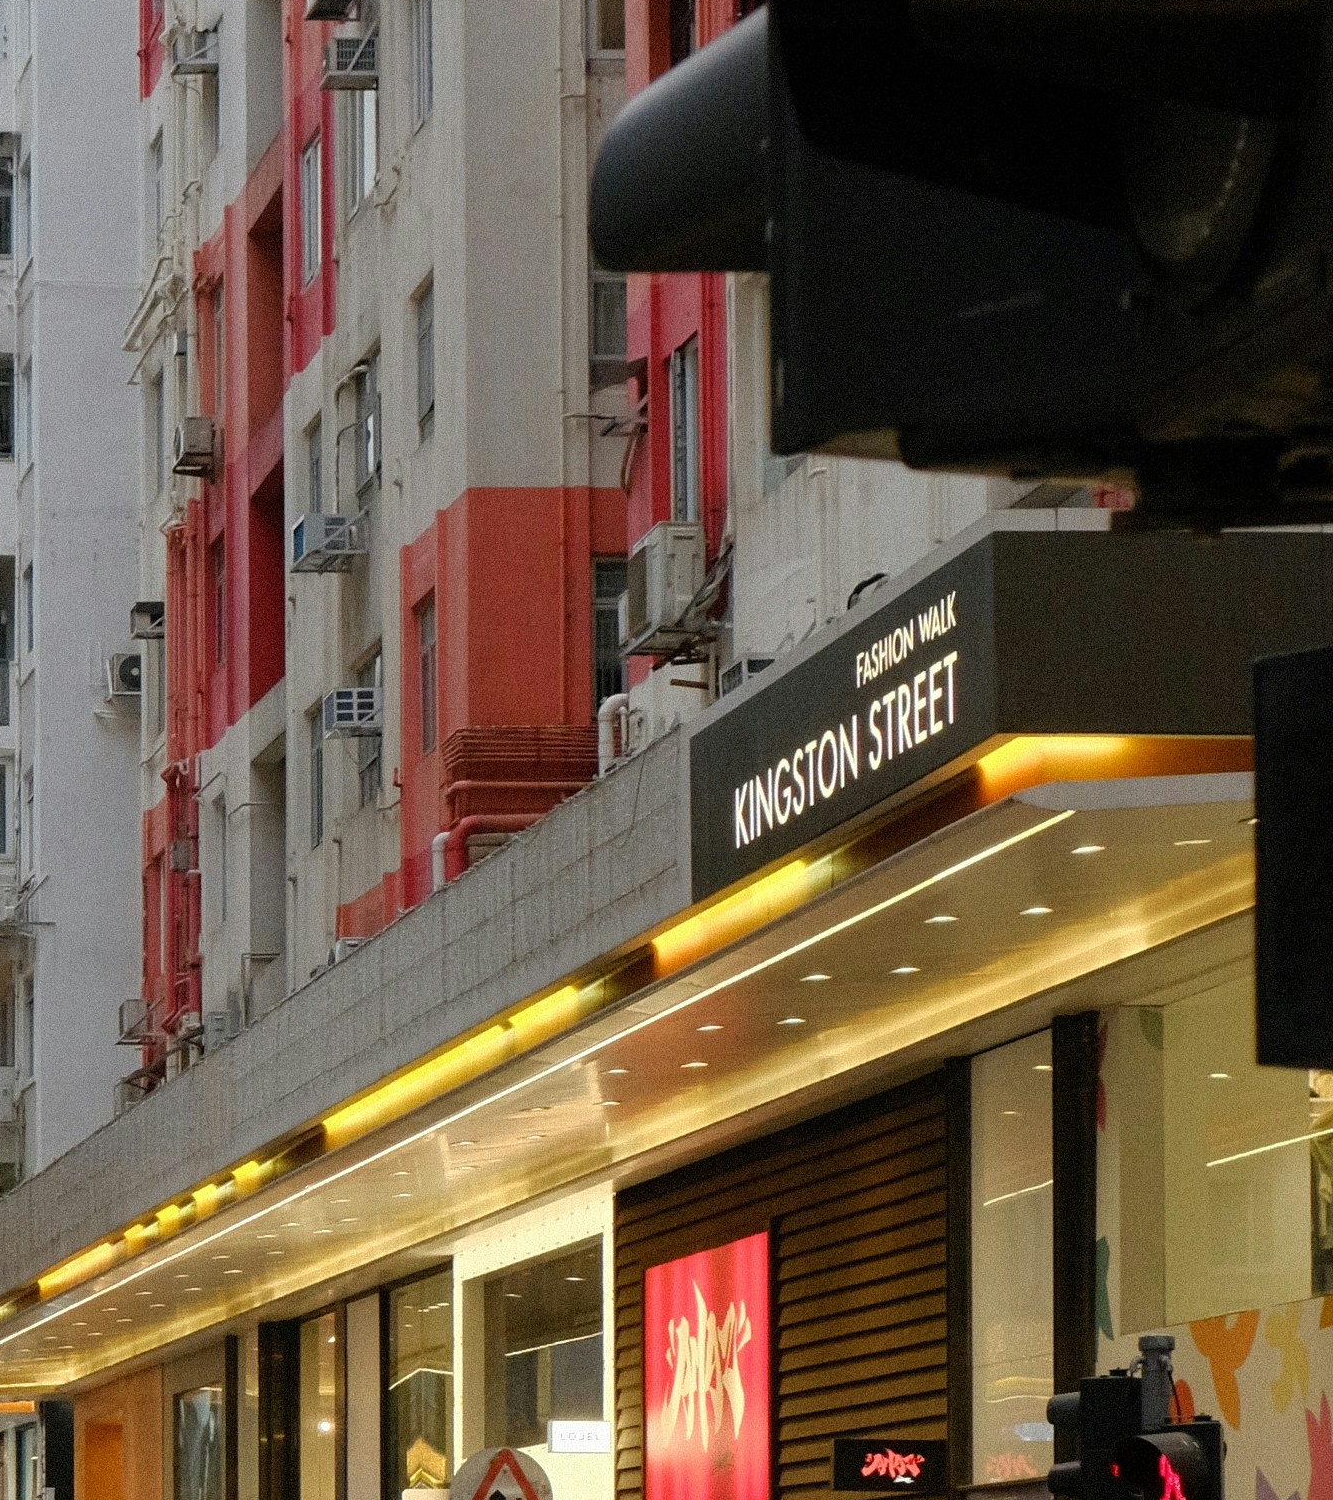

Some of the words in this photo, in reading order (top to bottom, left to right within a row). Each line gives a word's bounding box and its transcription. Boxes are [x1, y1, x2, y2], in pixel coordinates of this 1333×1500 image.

[855, 618, 915, 689] FASHION
[918, 590, 957, 644] WALK
[734, 713, 859, 850] KINGSTON
[868, 650, 959, 771] STREET
